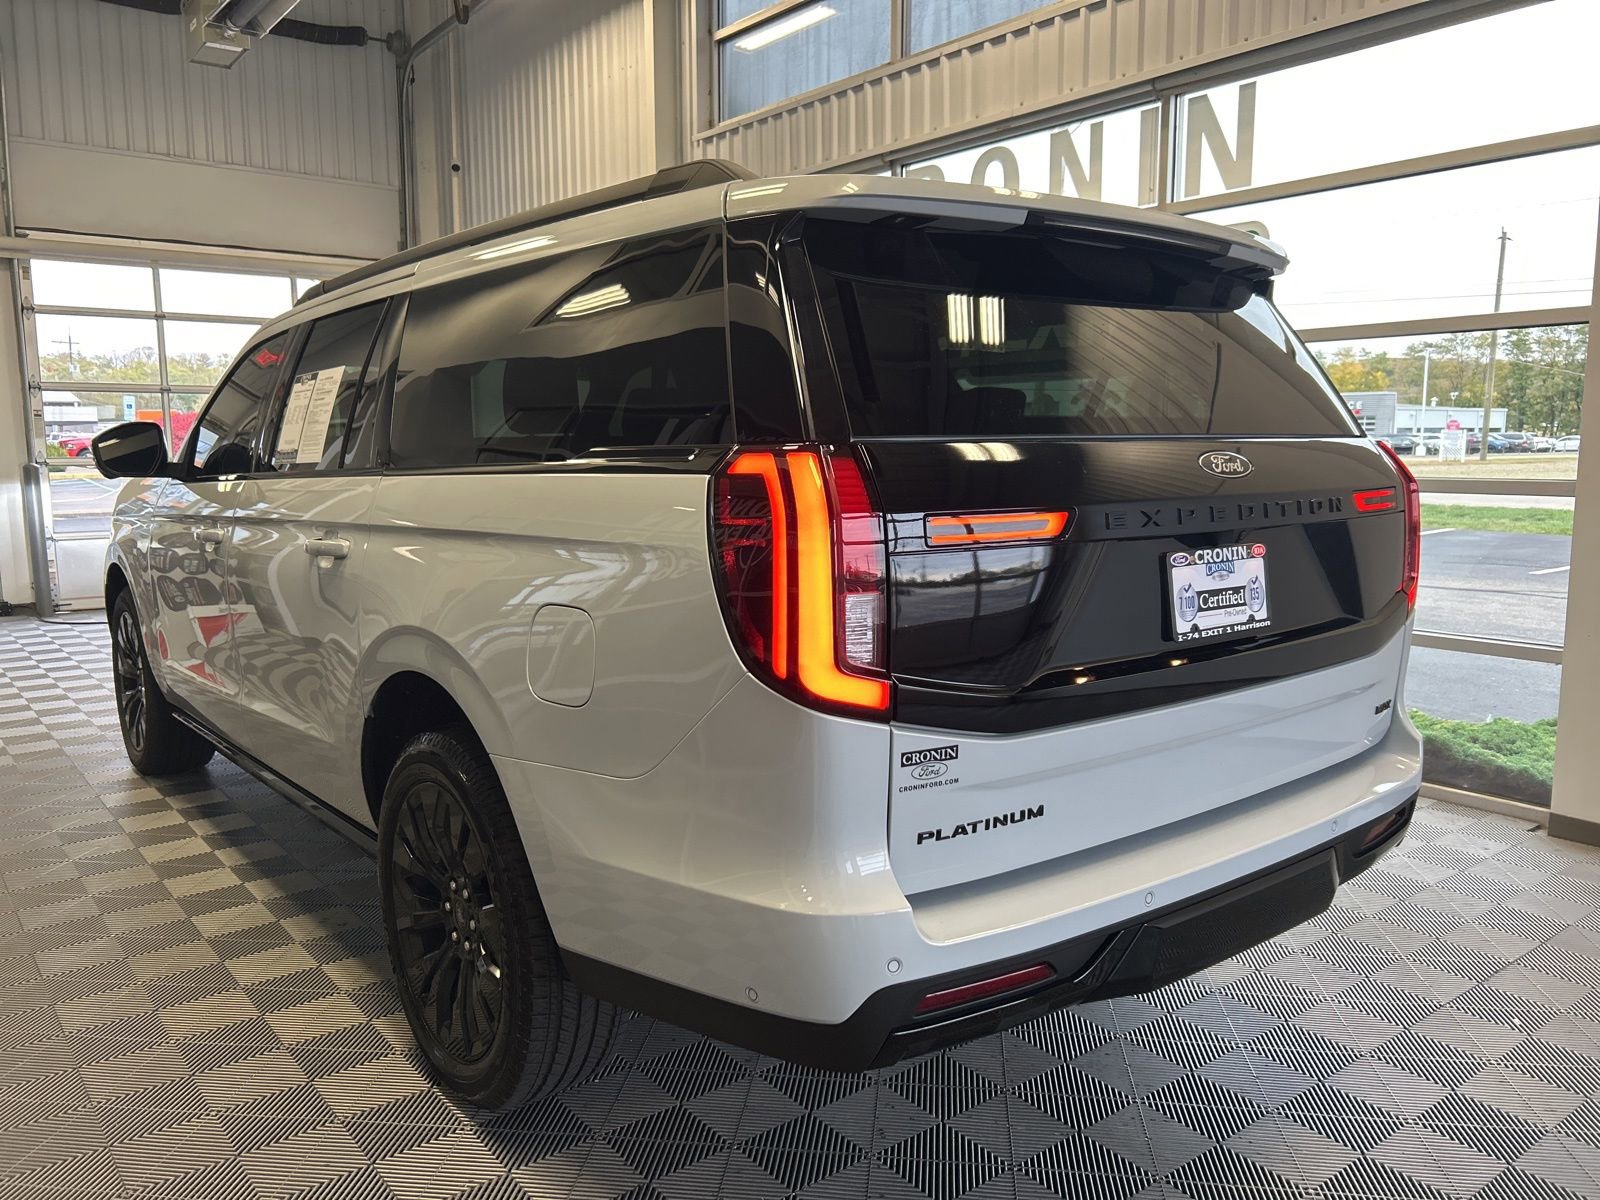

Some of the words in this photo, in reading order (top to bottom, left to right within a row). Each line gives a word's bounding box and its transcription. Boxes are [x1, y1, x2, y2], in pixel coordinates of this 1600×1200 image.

[1211, 455, 1244, 472] Ford
[1104, 496, 1344, 530] EXPEDITION
[1194, 545, 1247, 564] CRONIN
[1206, 561, 1234, 575] CRONIN
[1200, 589, 1245, 609] Certified
[1178, 632, 1200, 641] I-74
[1201, 627, 1224, 637] EXIT
[1234, 620, 1271, 632] Harrison
[902, 747, 958, 765] CRONIN
[918, 764, 941, 778] Ford
[898, 777, 960, 793] CRONINFORD.COM
[916, 804, 1045, 845] PLATINUM
